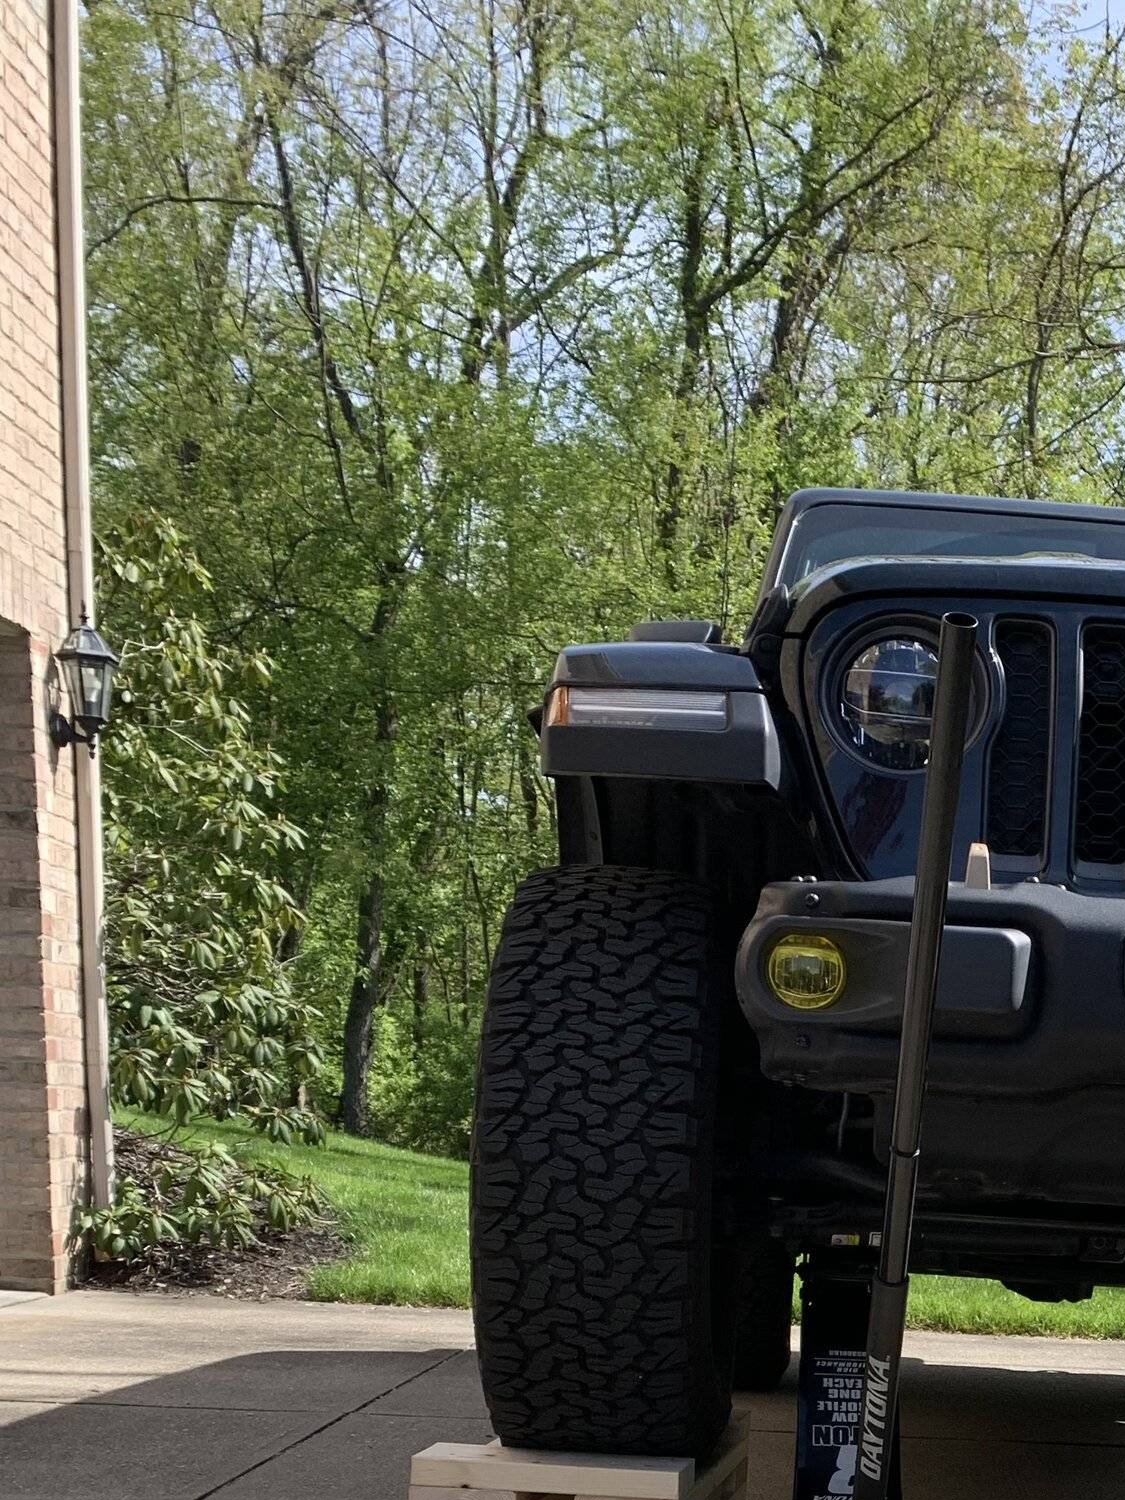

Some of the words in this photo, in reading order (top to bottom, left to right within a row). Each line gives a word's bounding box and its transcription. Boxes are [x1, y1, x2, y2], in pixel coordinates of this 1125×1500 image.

[823, 1378, 863, 1388] EACH
[828, 1389, 861, 1399] ONG
[860, 1355, 890, 1481] DAYTONA
